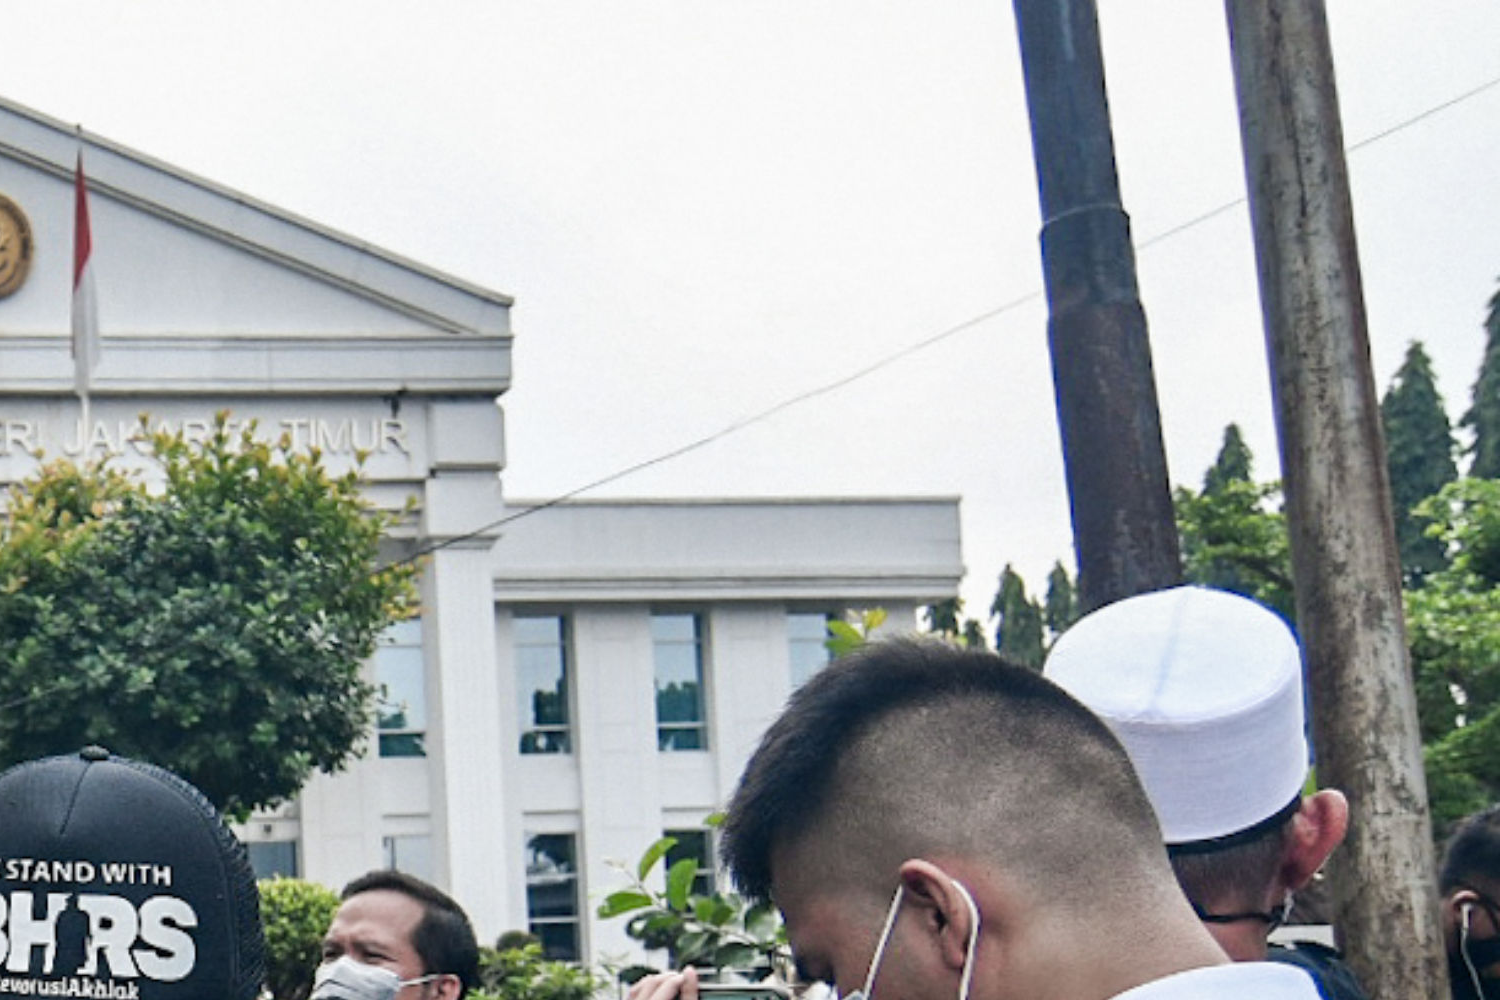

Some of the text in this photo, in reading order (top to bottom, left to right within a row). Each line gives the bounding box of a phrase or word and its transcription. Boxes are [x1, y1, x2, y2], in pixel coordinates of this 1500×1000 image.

[278, 418, 411, 458] TIMUR
[6, 859, 95, 883] STAND
[101, 863, 172, 887] WITH
